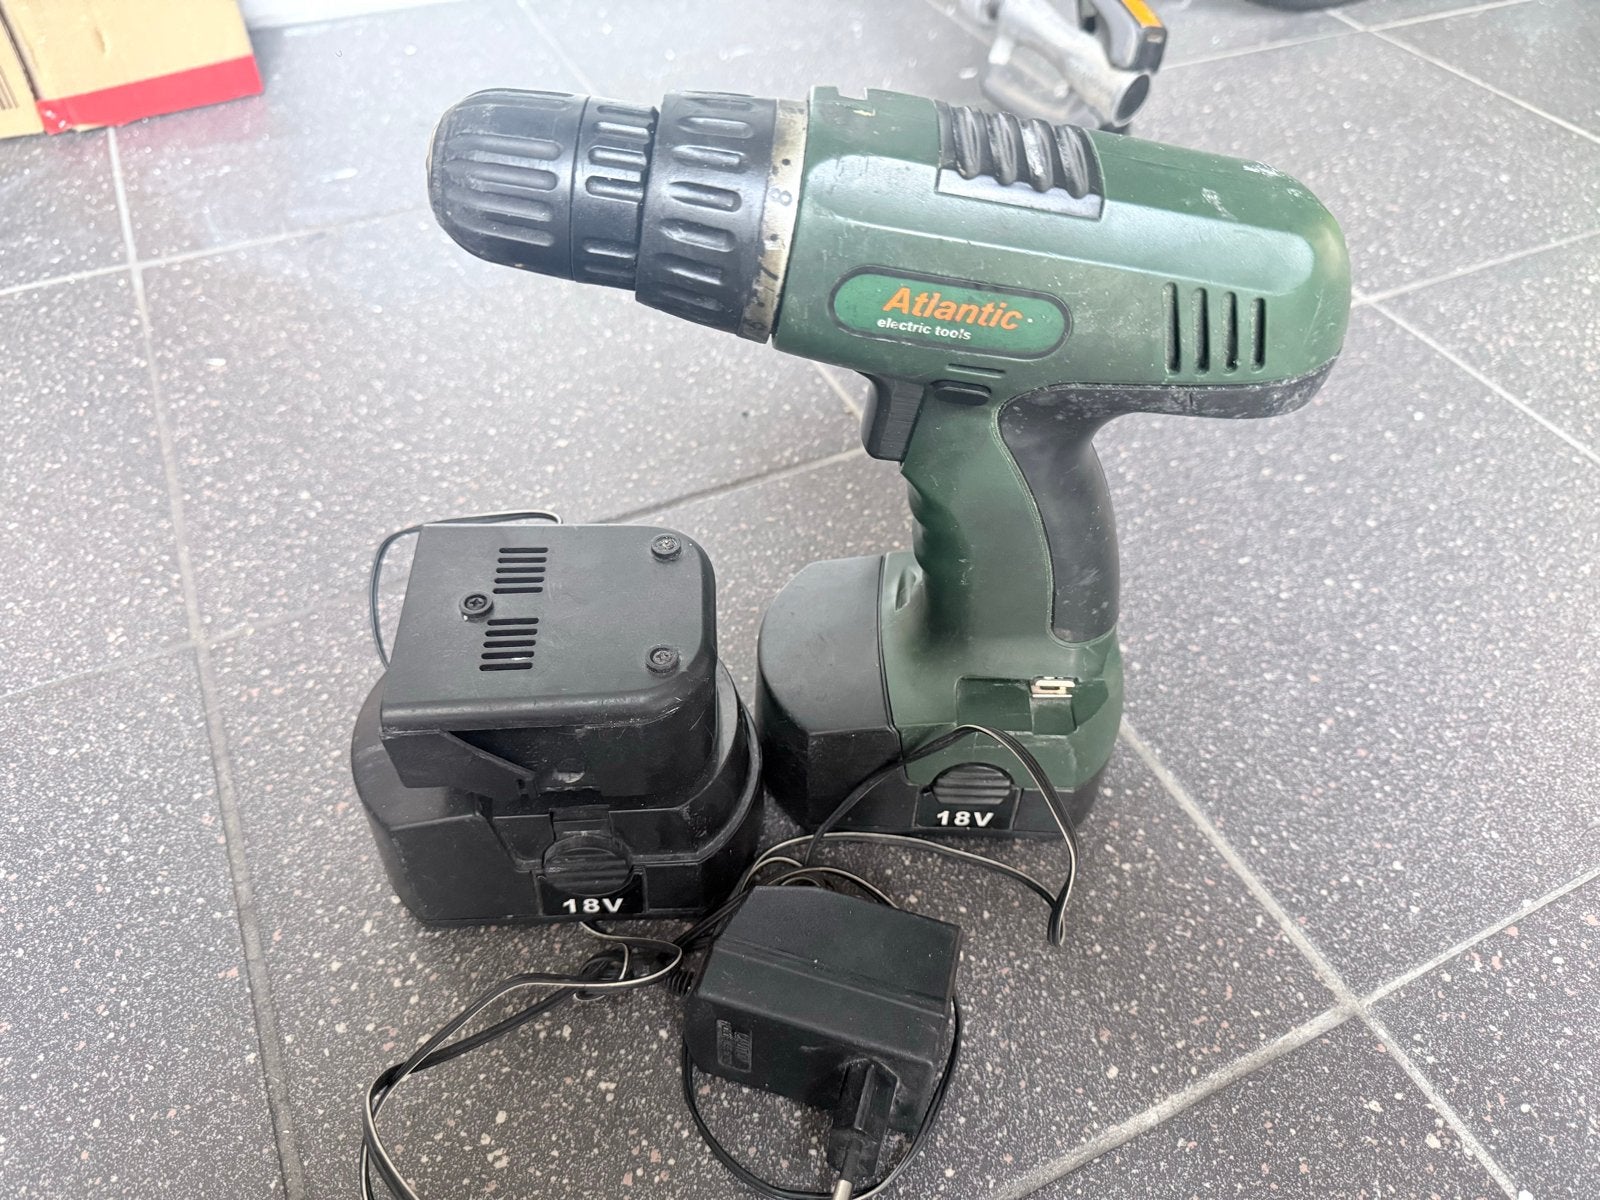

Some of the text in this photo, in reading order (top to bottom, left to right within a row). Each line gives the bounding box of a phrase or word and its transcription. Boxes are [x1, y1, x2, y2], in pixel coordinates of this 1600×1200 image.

[883, 286, 1024, 330] Atlantic
[877, 317, 973, 341] electric tools
[936, 810, 995, 827] 18V
[562, 898, 624, 913] 18V
